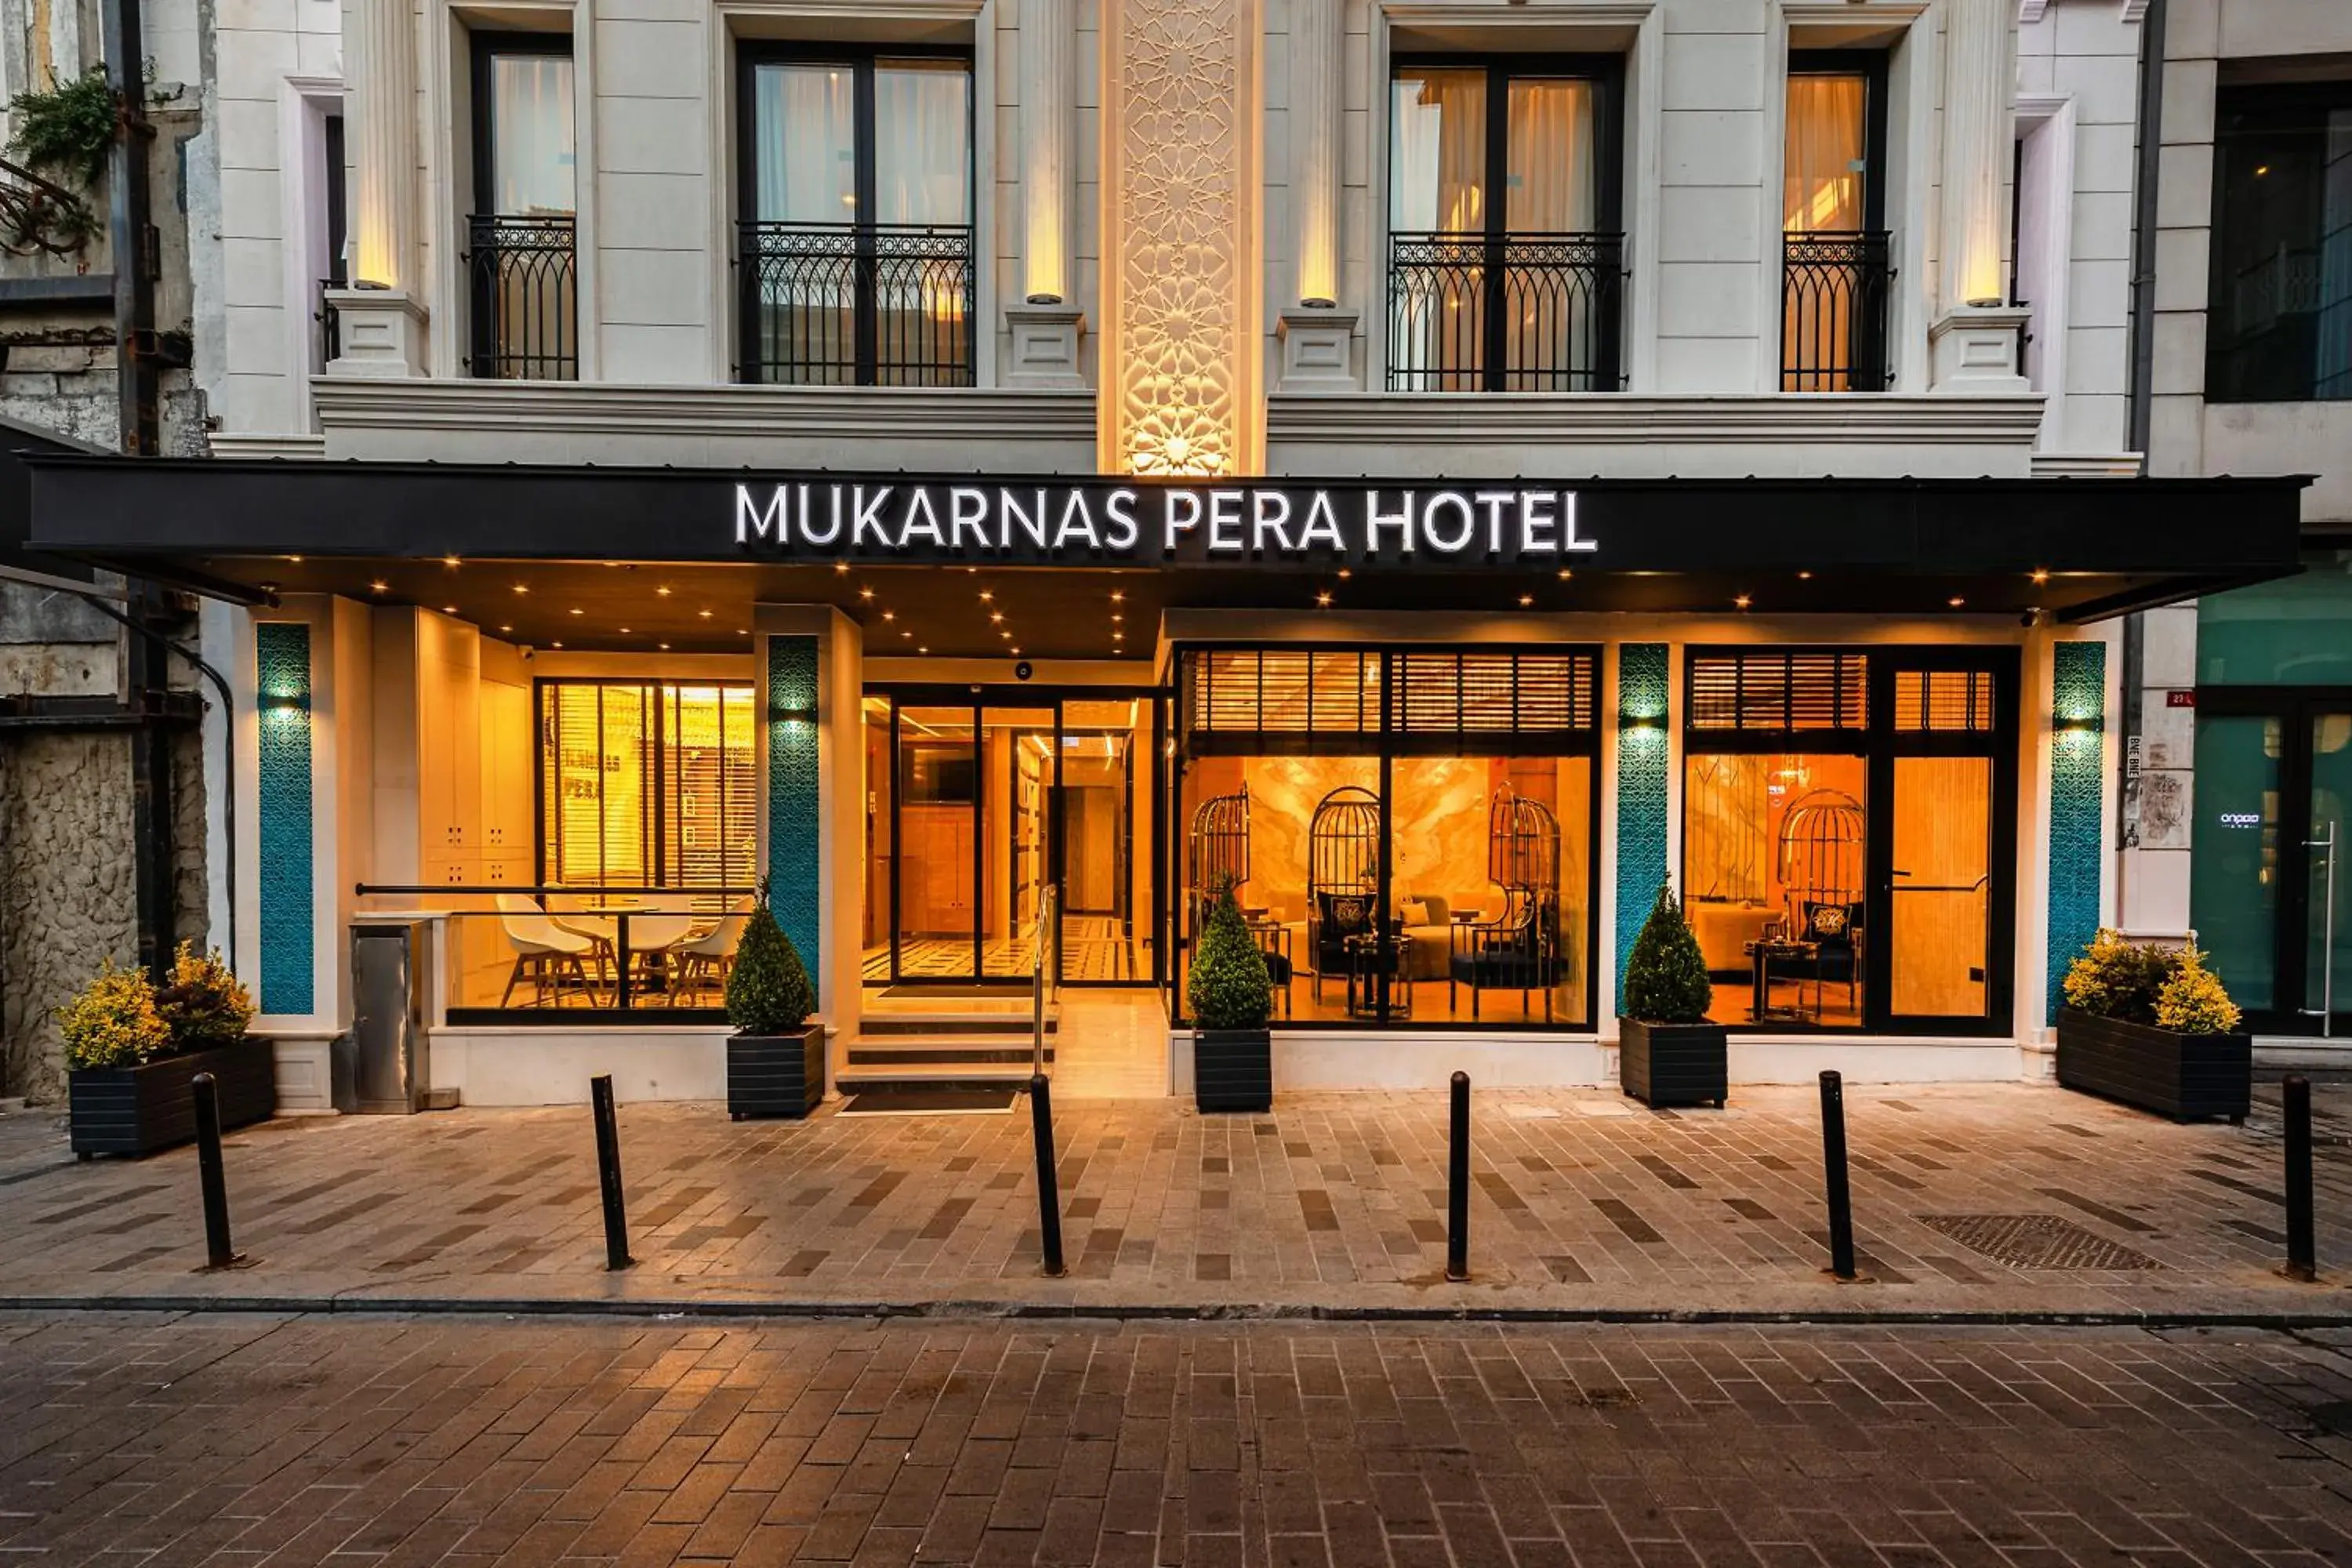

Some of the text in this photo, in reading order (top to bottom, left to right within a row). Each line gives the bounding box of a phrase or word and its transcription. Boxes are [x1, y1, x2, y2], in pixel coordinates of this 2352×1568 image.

[735, 484, 1598, 552] MUKARNAS PERA HOTEL
